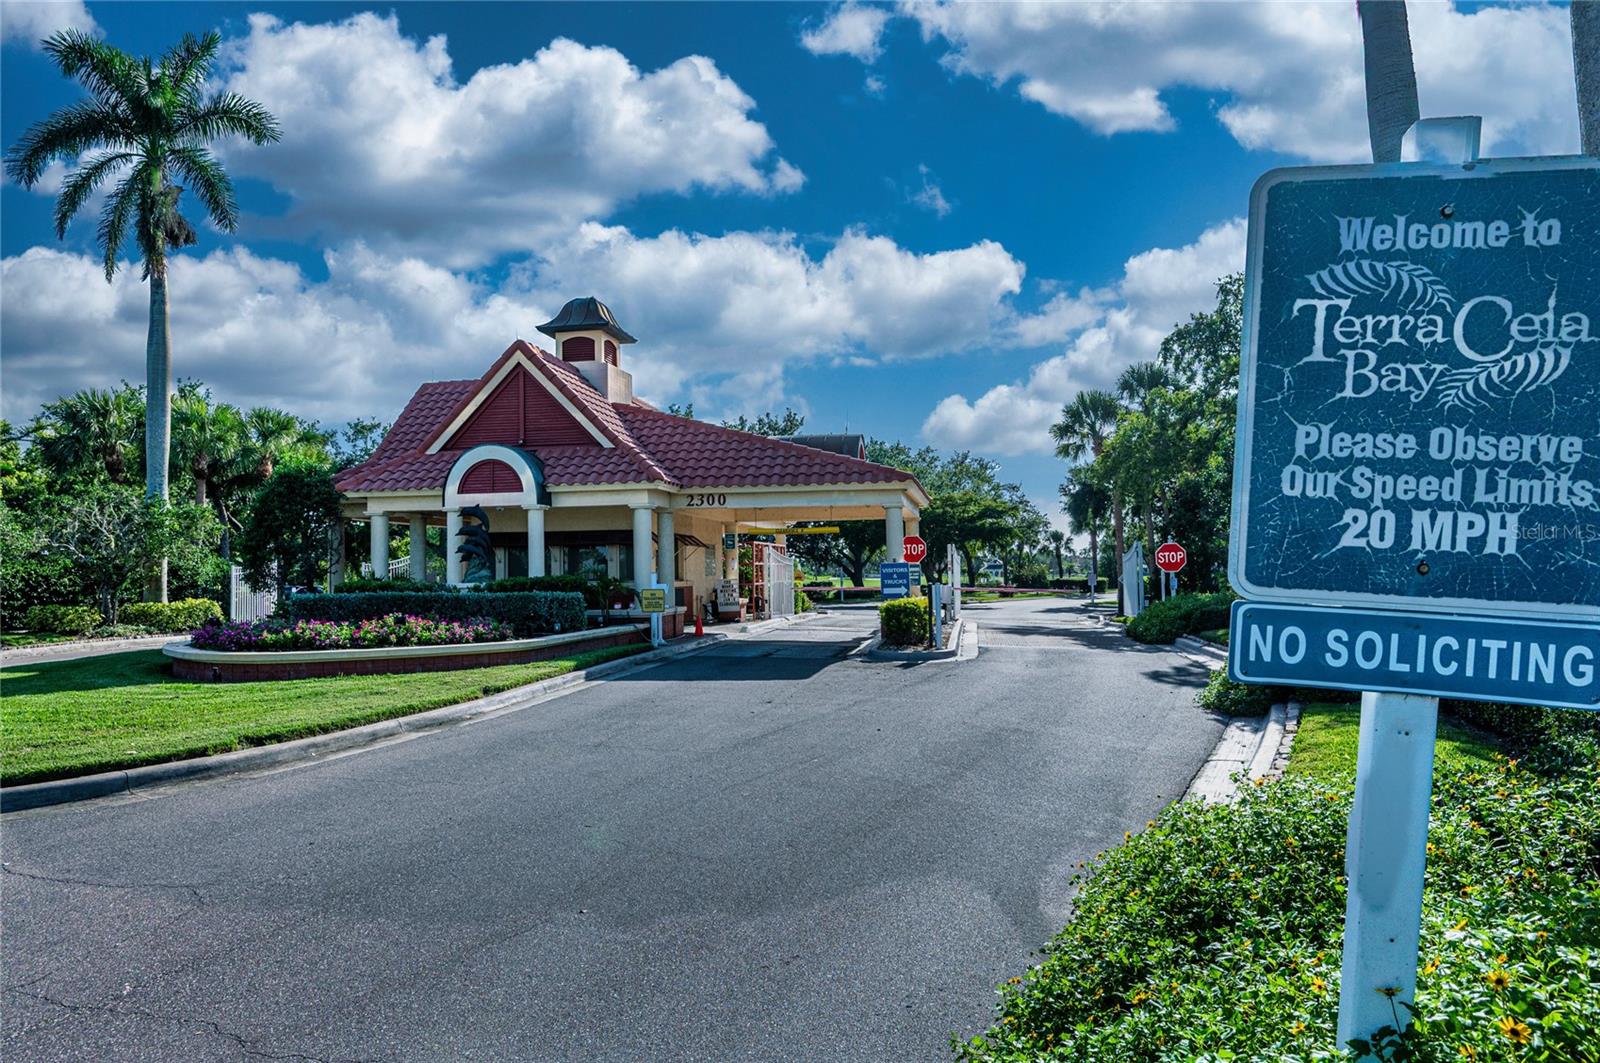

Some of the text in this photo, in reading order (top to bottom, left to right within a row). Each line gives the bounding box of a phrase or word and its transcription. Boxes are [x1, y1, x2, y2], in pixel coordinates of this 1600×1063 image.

[1338, 209, 1562, 252] Welcome to
[1292, 298, 1451, 362] Terra
[1336, 348, 1449, 402] Bay
[1293, 423, 1584, 464] Please Observe
[686, 493, 727, 507] 2300
[1280, 464, 1596, 508] Our Speed Limits
[1340, 508, 1521, 555] 20 MPH
[1158, 551, 1184, 563] STOP
[1248, 624, 1594, 688] NO SOLICITING
